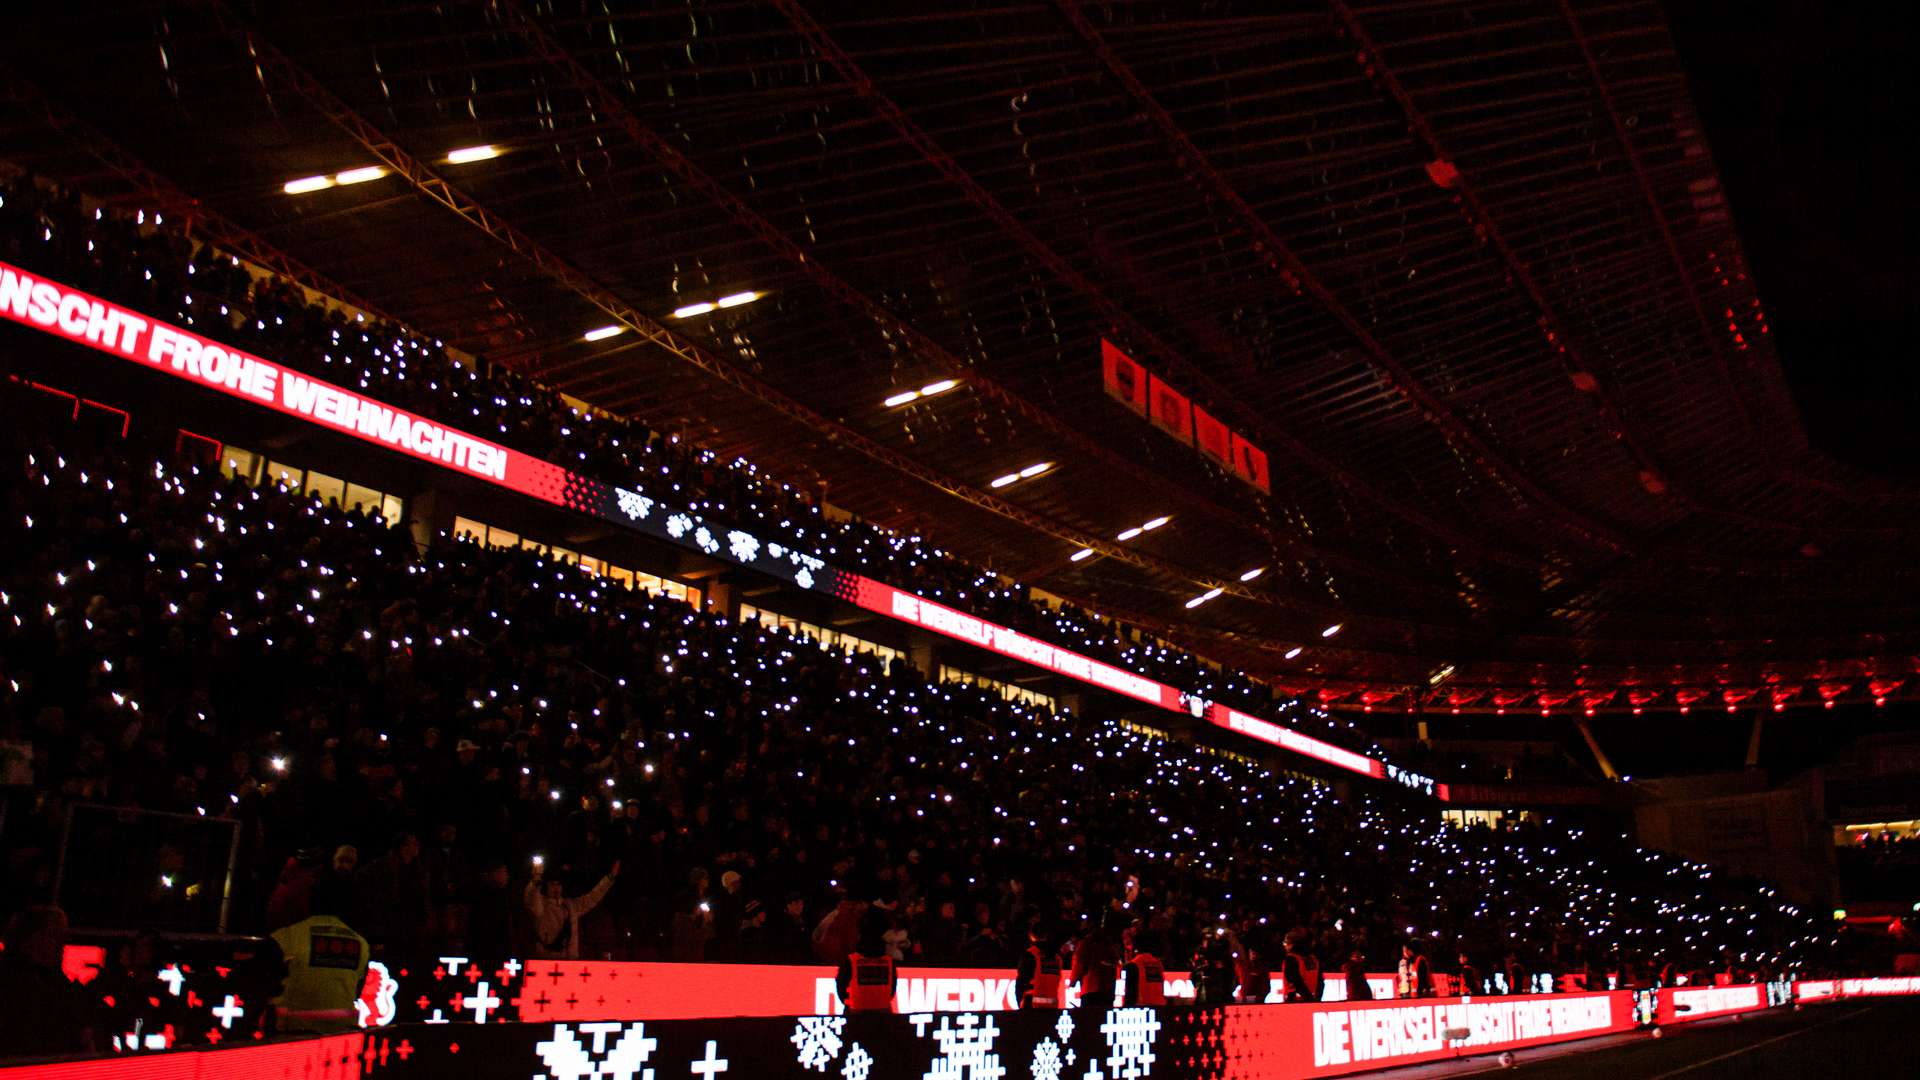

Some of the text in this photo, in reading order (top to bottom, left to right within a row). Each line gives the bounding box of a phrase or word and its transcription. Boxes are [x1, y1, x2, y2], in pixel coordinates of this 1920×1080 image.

[0, 266, 507, 480] NSCHT FROHE WEIHNACHTEN
[1312, 1010, 1351, 1067] DIE
[1350, 1005, 1447, 1061] WERKSELF
